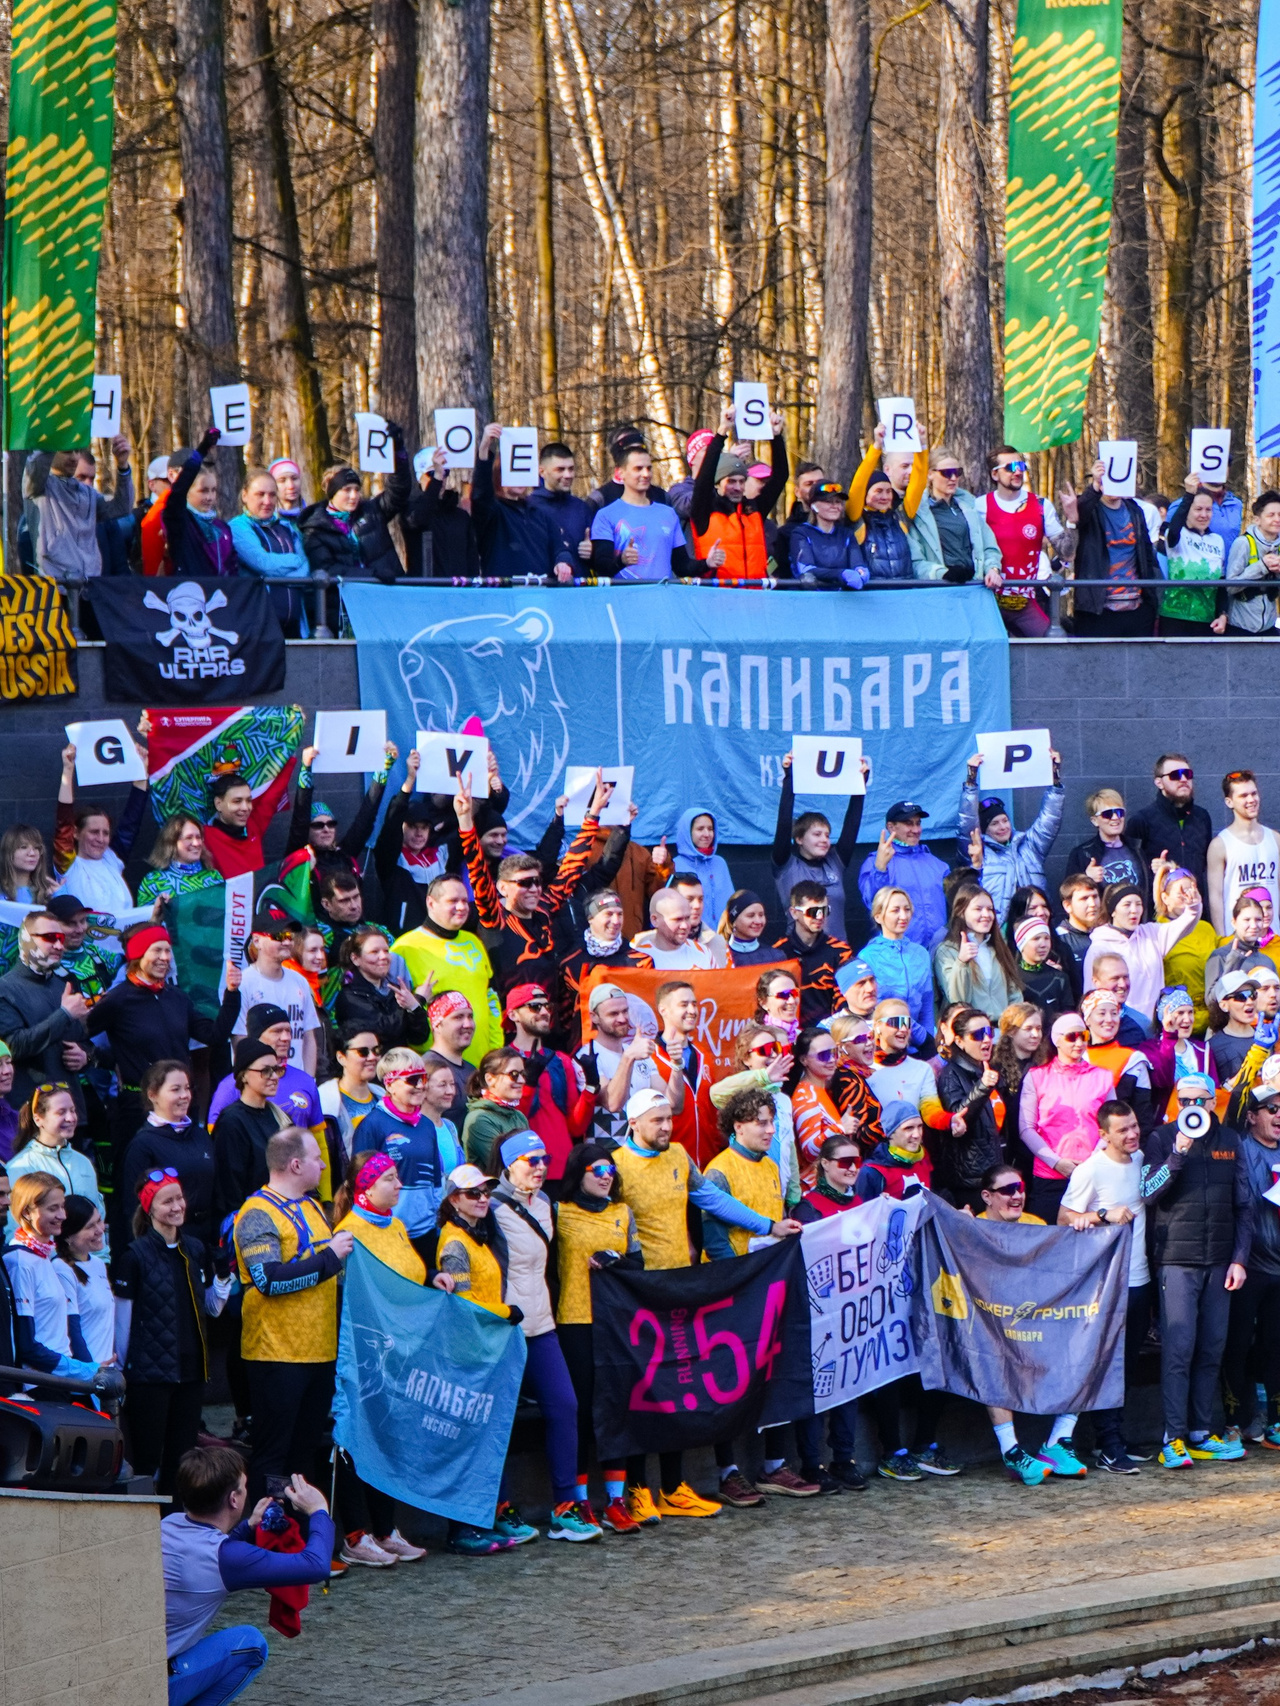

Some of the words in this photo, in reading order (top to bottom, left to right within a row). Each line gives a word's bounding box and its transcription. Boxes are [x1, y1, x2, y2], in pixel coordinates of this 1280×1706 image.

[92, 390, 114, 420] H
[226, 402, 245, 432] E
[367, 430, 388, 458] R
[445, 425, 473, 454] O
[510, 444, 532, 473] E
[744, 399, 766, 427] S
[892, 413, 913, 440] R
[1108, 456, 1133, 483] U
[1201, 445, 1225, 471] S
[0, 651, 76, 699] USSIA
[159, 659, 246, 680] ULTRAS
[174, 646, 230, 664] RHR
[662, 648, 971, 732] КАПИБАРА
[94, 736, 125, 765] G
[346, 726, 360, 755] I
[446, 748, 472, 778] V
[816, 750, 845, 778] U
[1003, 744, 1032, 773] P
[1238, 862, 1276, 883] M42.2
[1032, 1302, 1099, 1320] ГРУППА
[677, 1307, 694, 1385] RUNNING
[405, 1368, 495, 1424] КАПИБАРА
